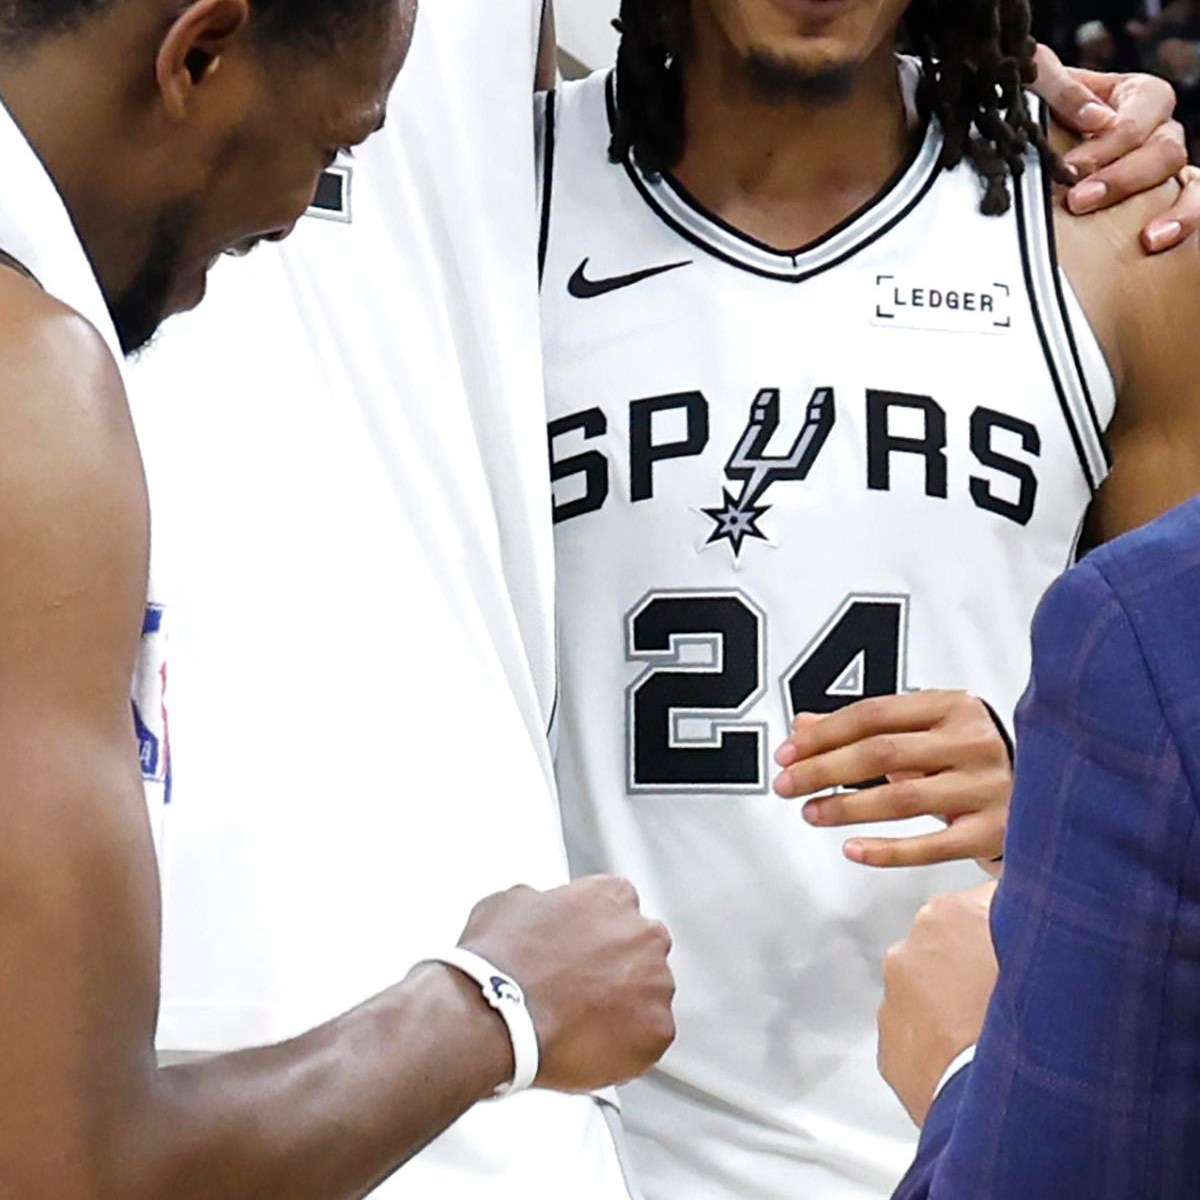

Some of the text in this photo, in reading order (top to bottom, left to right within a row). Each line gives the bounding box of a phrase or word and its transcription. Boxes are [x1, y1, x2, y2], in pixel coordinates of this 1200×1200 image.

[894, 287, 994, 313] LEDGER
[547, 387, 1042, 558] SPURS
[624, 587, 914, 796] 24
